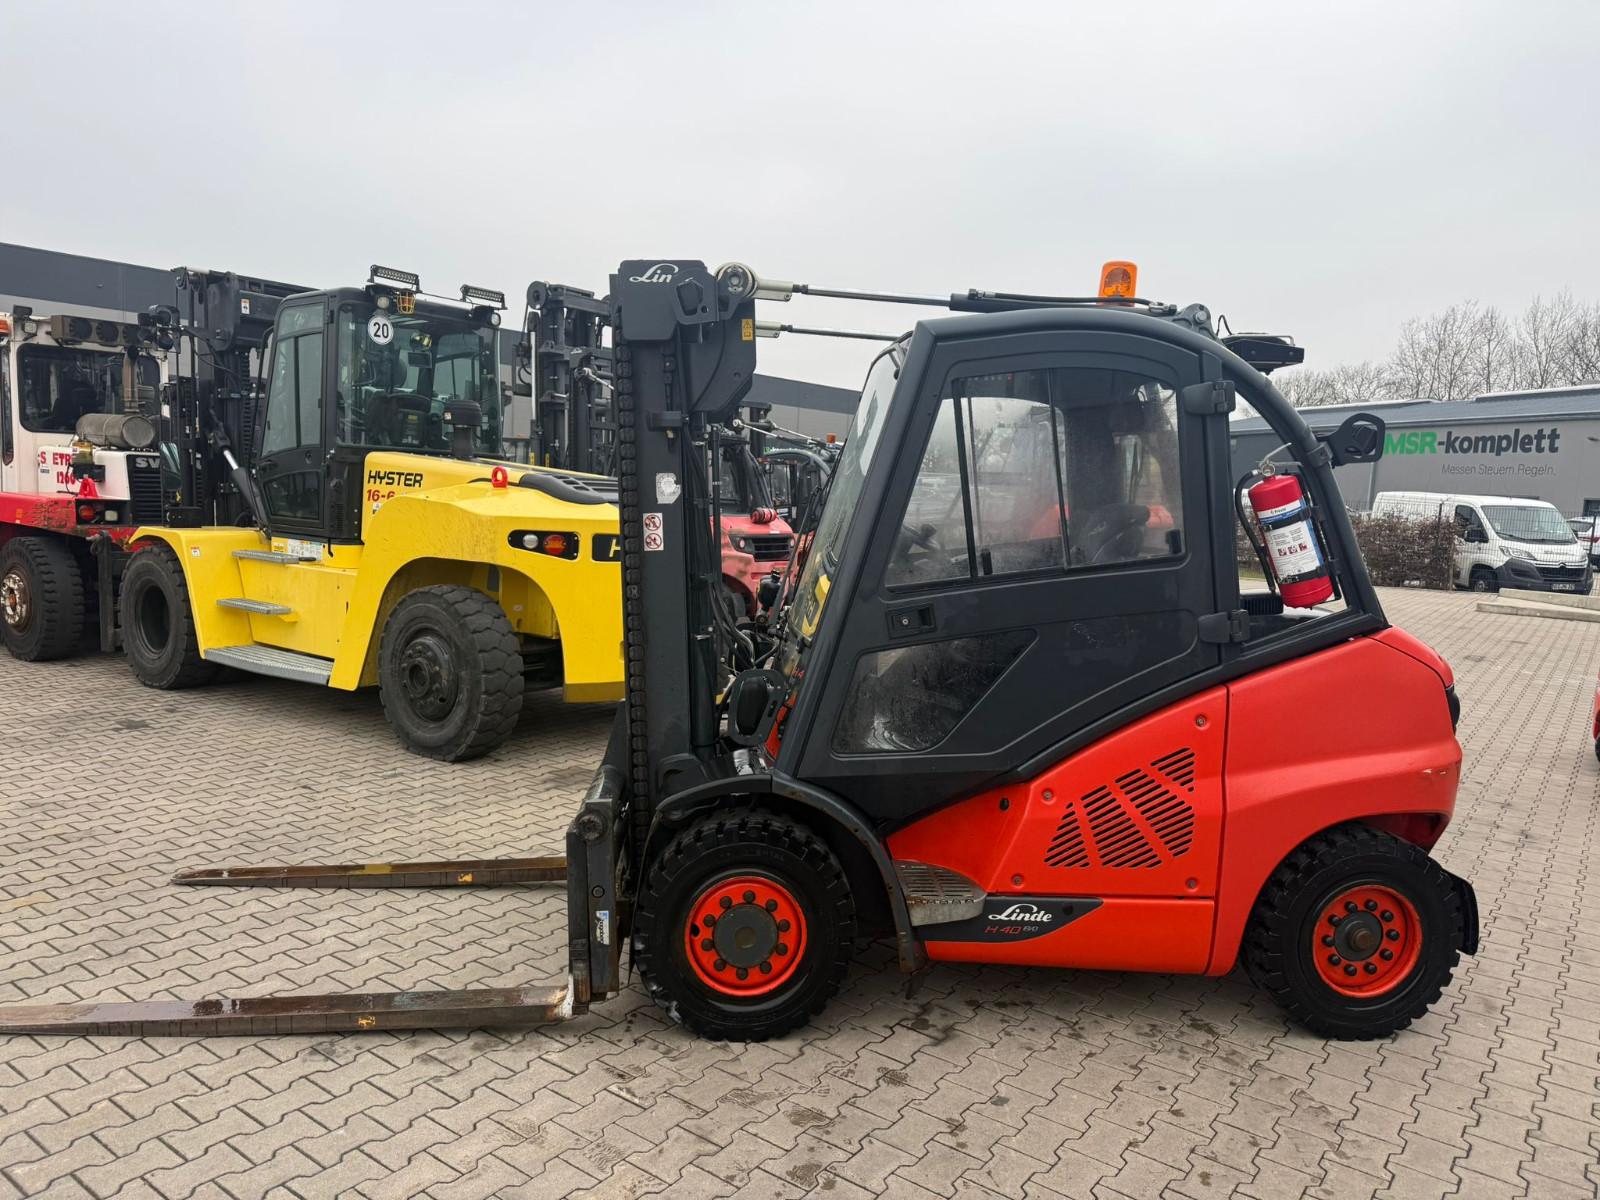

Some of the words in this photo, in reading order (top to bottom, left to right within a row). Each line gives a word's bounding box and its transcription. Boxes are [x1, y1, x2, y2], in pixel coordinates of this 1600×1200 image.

[629, 263, 679, 283] Lin
[373, 321, 389, 338] 20
[1384, 428, 1561, 456] MSR-komplett
[367, 469, 424, 488] HYSTER
[988, 903, 1053, 922] Linde
